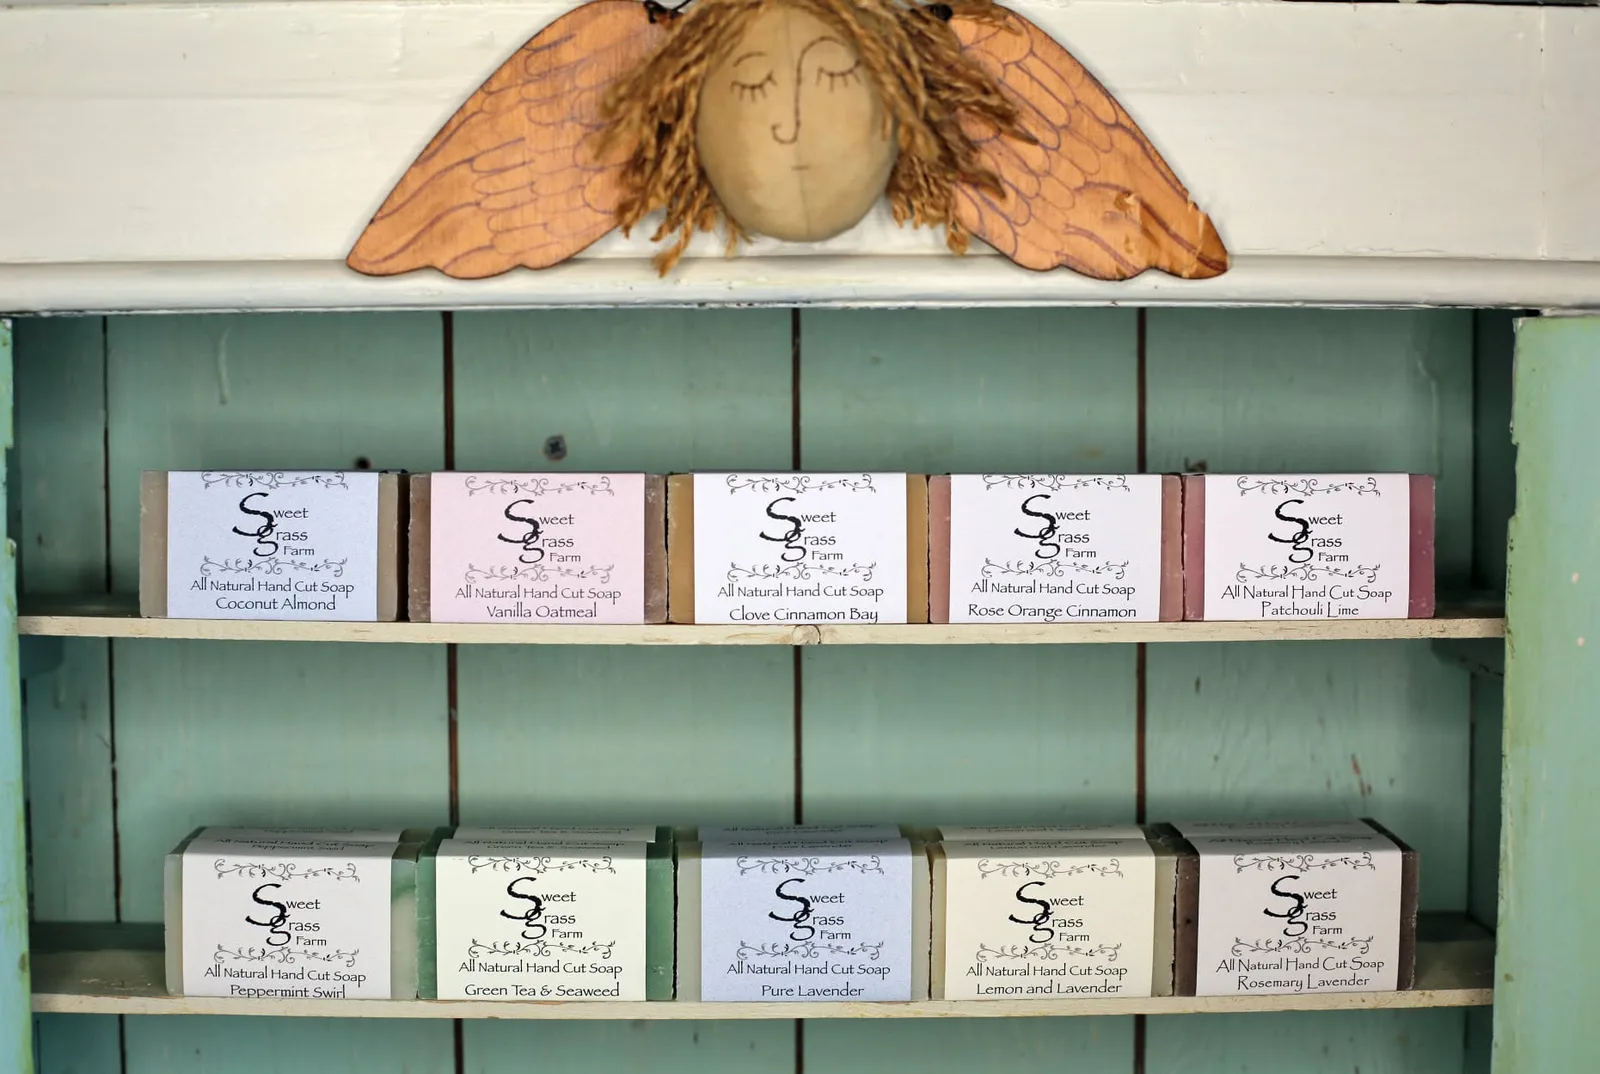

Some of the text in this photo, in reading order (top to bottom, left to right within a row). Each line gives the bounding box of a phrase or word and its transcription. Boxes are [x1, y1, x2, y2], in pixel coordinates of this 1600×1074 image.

[284, 546, 314, 556] Farm
[550, 553, 581, 562] Farm
[812, 551, 843, 560] Farm
[1065, 548, 1096, 558] Farm
[1319, 552, 1348, 562] Farm
[190, 577, 354, 598] All Natural Hand Cut Soap
[455, 585, 621, 605] All Natural Hand Cut Soap
[718, 584, 884, 602] All Natural Hand Cut Soap
[971, 579, 1135, 600] All Natural Hand Cut Soap
[1221, 585, 1392, 602] All Natural Hand Cut Soap
[216, 594, 336, 610] Coconut Almond
[1262, 602, 1359, 617] Patchouli Lime
[486, 602, 597, 618] Vanilla Oatmeal
[729, 605, 878, 623] Clove Cinnamon Bay
[968, 604, 1136, 622] Rose Orange Cinnamon
[552, 929, 582, 938] Farm
[820, 930, 851, 940] Farm
[1060, 933, 1089, 941] Farm
[1313, 926, 1342, 934] Farm
[296, 936, 326, 946] Farm
[459, 959, 623, 979] All Natural Hand Cut Soap
[727, 961, 890, 980] All Natural Hand Cut Soap
[966, 963, 1127, 980] All Natural Hand Cut Soap
[1216, 957, 1384, 972] All Natural Hand Cut Soap
[204, 964, 366, 987] All Natural Hand Cut Soap
[1238, 973, 1370, 992] Rosemary Lavender
[231, 985, 345, 998] Peppermint Swirl
[465, 982, 619, 996] Green Tea & Seaweed
[762, 982, 864, 996] Pure Lavender
[977, 979, 1122, 995] Lemon and Lavender
